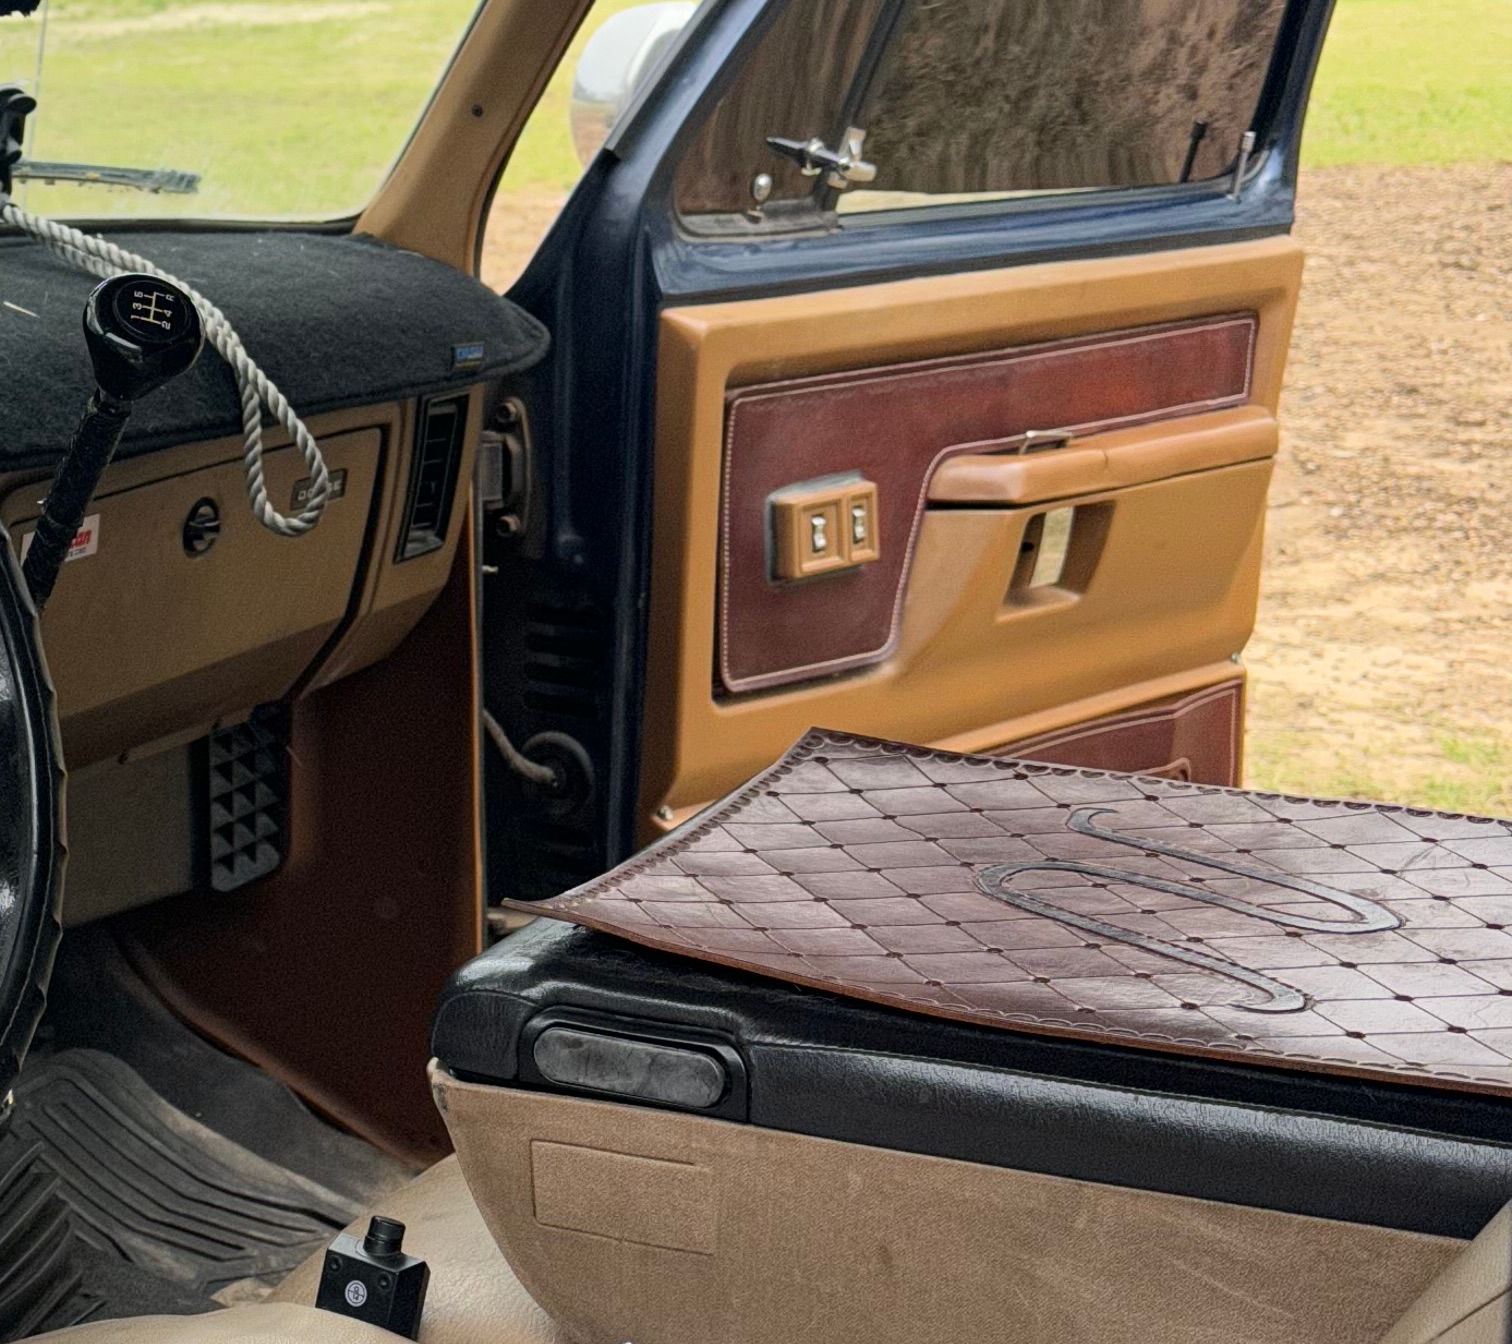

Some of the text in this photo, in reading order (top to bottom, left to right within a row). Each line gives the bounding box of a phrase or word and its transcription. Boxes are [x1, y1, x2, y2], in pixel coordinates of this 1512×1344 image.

[134, 290, 144, 298] 5
[132, 302, 143, 310] 3
[161, 294, 175, 330] 2 4 R
